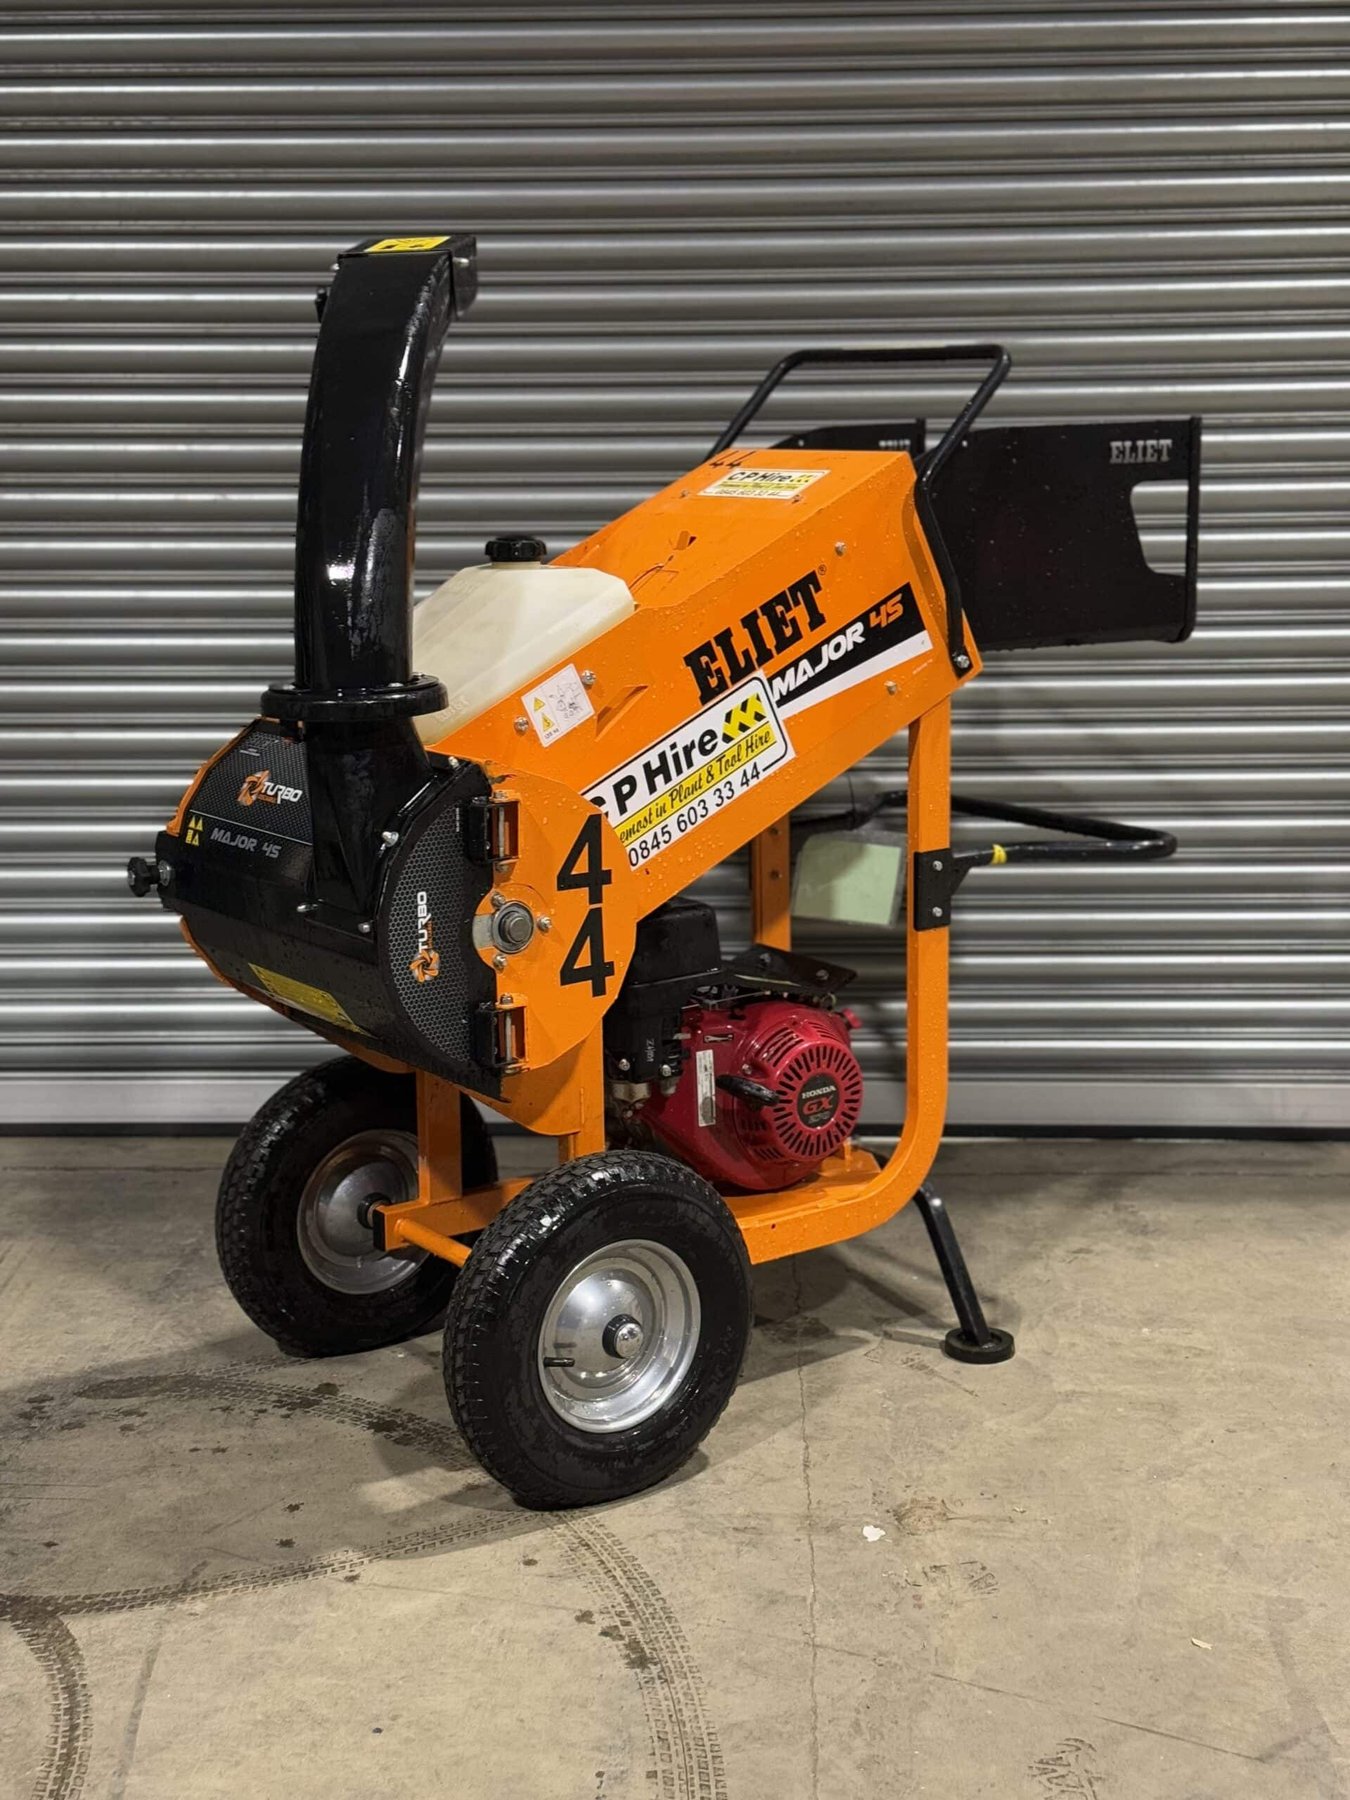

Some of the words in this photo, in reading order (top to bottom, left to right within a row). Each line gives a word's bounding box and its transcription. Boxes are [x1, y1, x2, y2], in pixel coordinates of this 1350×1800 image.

[1109, 438, 1173, 464] ELIET
[683, 569, 827, 705] ELIET
[772, 621, 866, 701] MAJOR
[869, 593, 904, 628] 45
[261, 780, 303, 804] TURBO
[612, 774, 638, 817] P
[642, 728, 719, 796] Hire
[655, 802, 667, 818] in
[668, 775, 704, 810] Plant
[706, 763, 715, 784] &
[716, 748, 742, 776] Tool
[745, 730, 771, 759] Hire
[210, 827, 258, 852] MAJOR
[262, 842, 282, 858] 45
[628, 823, 672, 867] 0845
[676, 798, 709, 833] 603
[713, 780, 736, 808] 33
[740, 761, 761, 788] 44
[416, 890, 432, 953] TURBO
[801, 1085, 837, 1099] HONDA
[802, 1094, 834, 1115] GX
